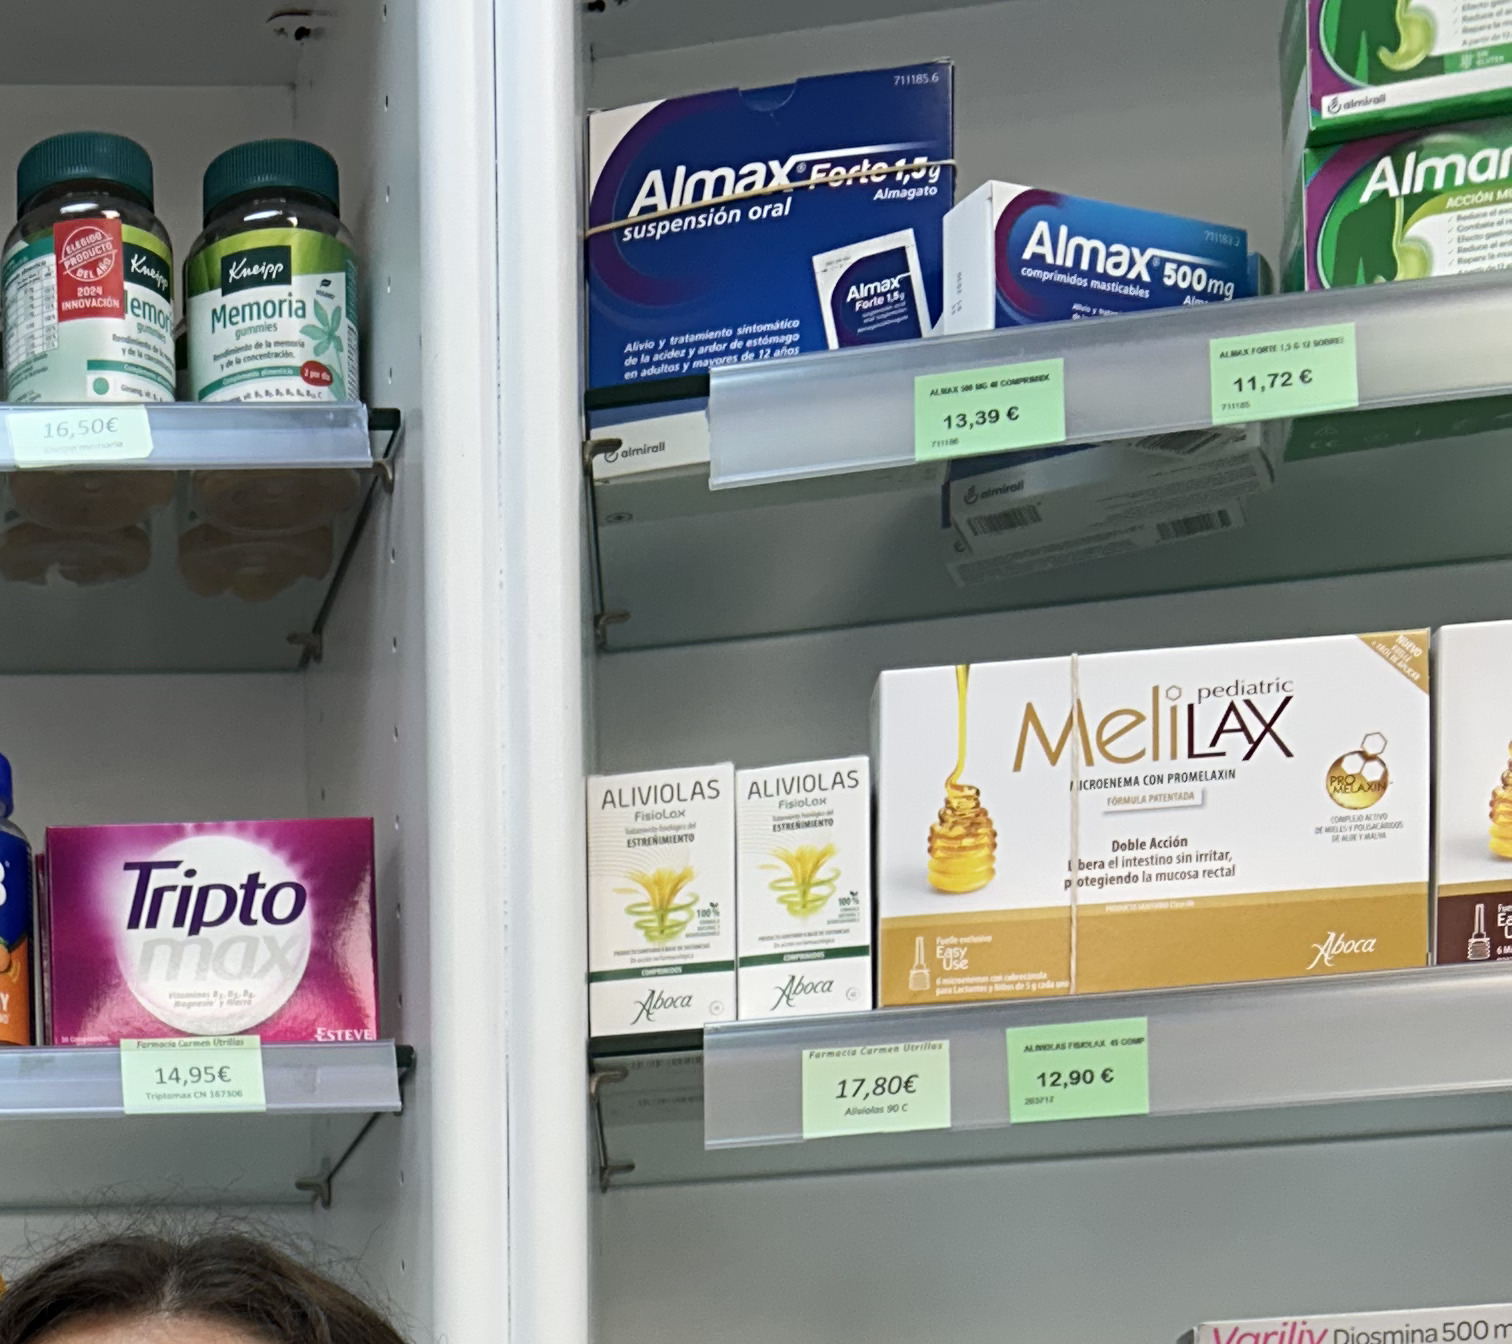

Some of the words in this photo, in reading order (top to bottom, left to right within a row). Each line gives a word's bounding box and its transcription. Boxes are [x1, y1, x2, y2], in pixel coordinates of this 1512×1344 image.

[627, 156, 797, 219] Almax
[874, 184, 938, 201] Almagato
[622, 206, 741, 241] suspensión
[748, 198, 792, 219] oral
[1021, 220, 1153, 282] Almax
[229, 259, 285, 284] Kneipp
[1021, 266, 1088, 287] comprimidos
[1091, 275, 1150, 299] masticables
[61, 295, 121, 312] INNOVACIÓN
[75, 285, 103, 297] 2024
[210, 291, 307, 332] Memoria
[1233, 371, 1295, 393] 11,72
[1299, 368, 1313, 384] €
[42, 415, 120, 438] 16,50€
[942, 409, 1000, 431] 13,39
[1006, 405, 1020, 421] €
[1197, 677, 1294, 704] pediatric
[1143, 774, 1164, 786] CON
[1167, 769, 1236, 784] PROMELAXIN
[602, 779, 721, 810] ALIVIOLAS
[1112, 840, 1146, 852] Doble
[1150, 836, 1188, 849] Acción
[1155, 869, 1199, 881] mucosa
[1202, 864, 1236, 878] rectal
[123, 859, 307, 937] Tripto
[137, 933, 299, 985] max
[1306, 932, 1377, 969] Aboca
[314, 1026, 372, 1042] ESTEVE
[154, 1064, 233, 1087] 14,95€
[835, 1074, 919, 1100] 17,80€
[1037, 1069, 1094, 1088] 12,90
[1101, 1068, 1114, 1083] €
